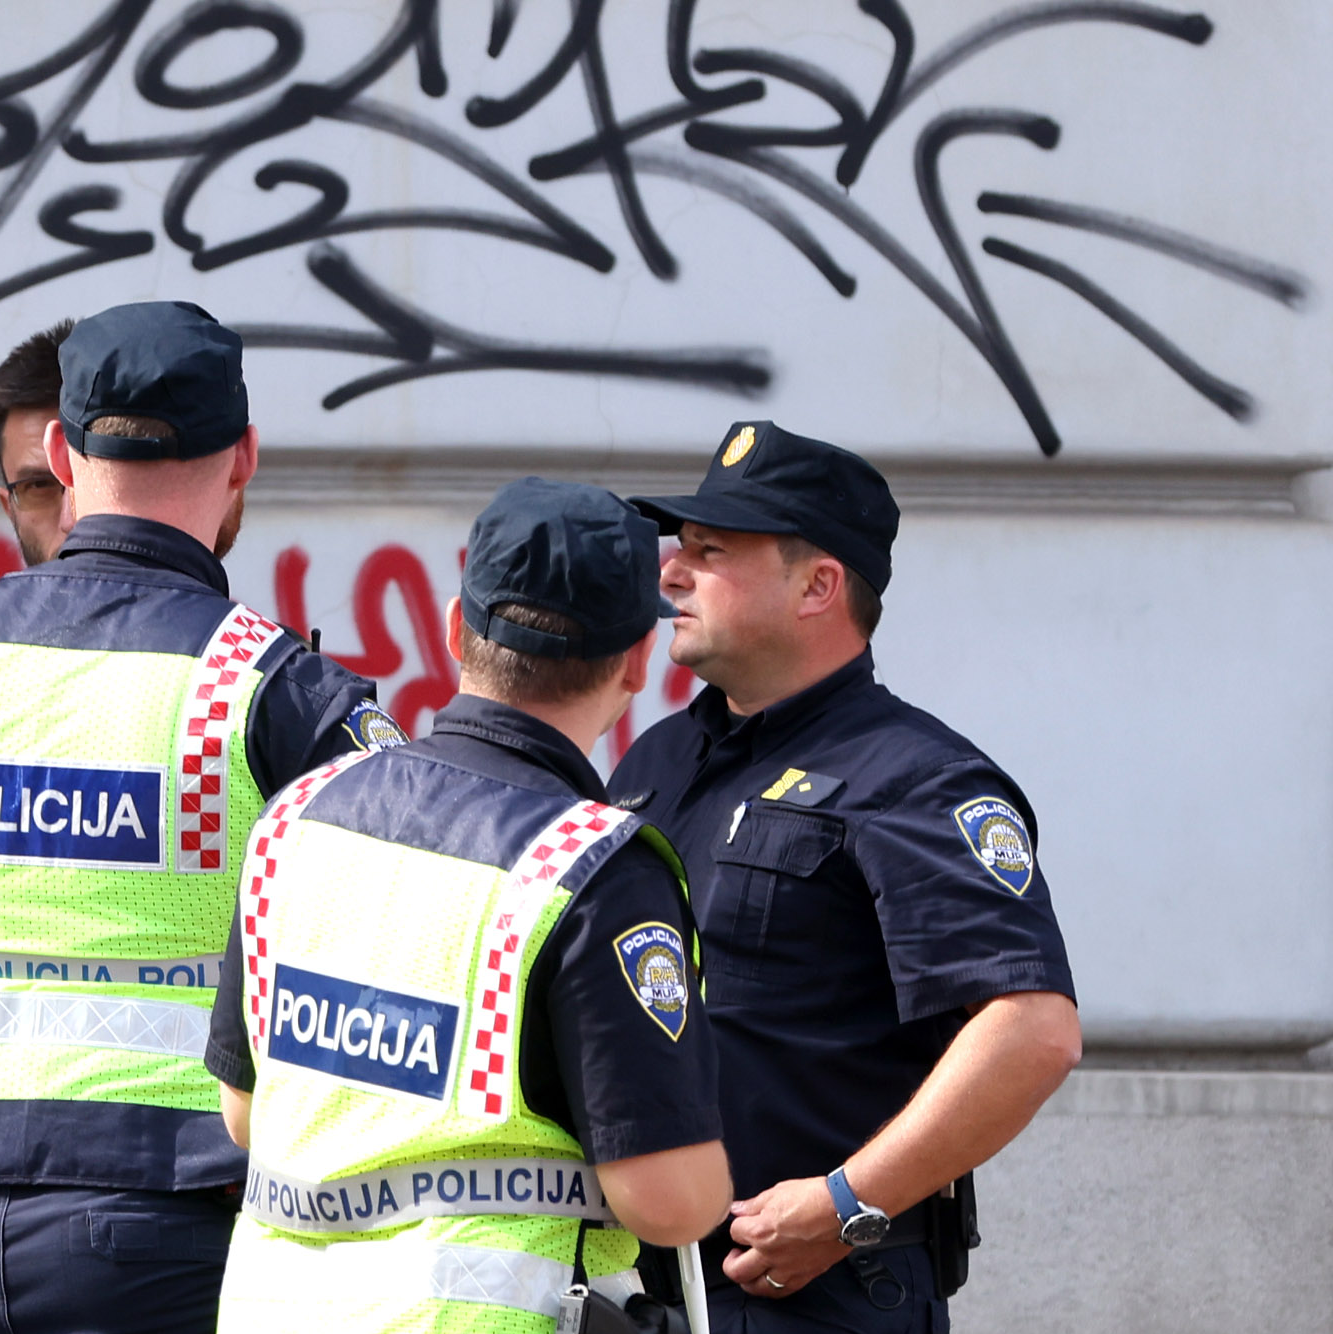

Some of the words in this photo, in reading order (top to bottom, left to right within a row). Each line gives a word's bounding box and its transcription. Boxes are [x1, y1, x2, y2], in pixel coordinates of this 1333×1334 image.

[622, 929, 682, 956] POLICIJA
[652, 987, 678, 999] MUP
[275, 988, 439, 1075] POLICIJA
[268, 1178, 399, 1223] POLICIJA
[412, 1167, 587, 1208] POLICIJA
